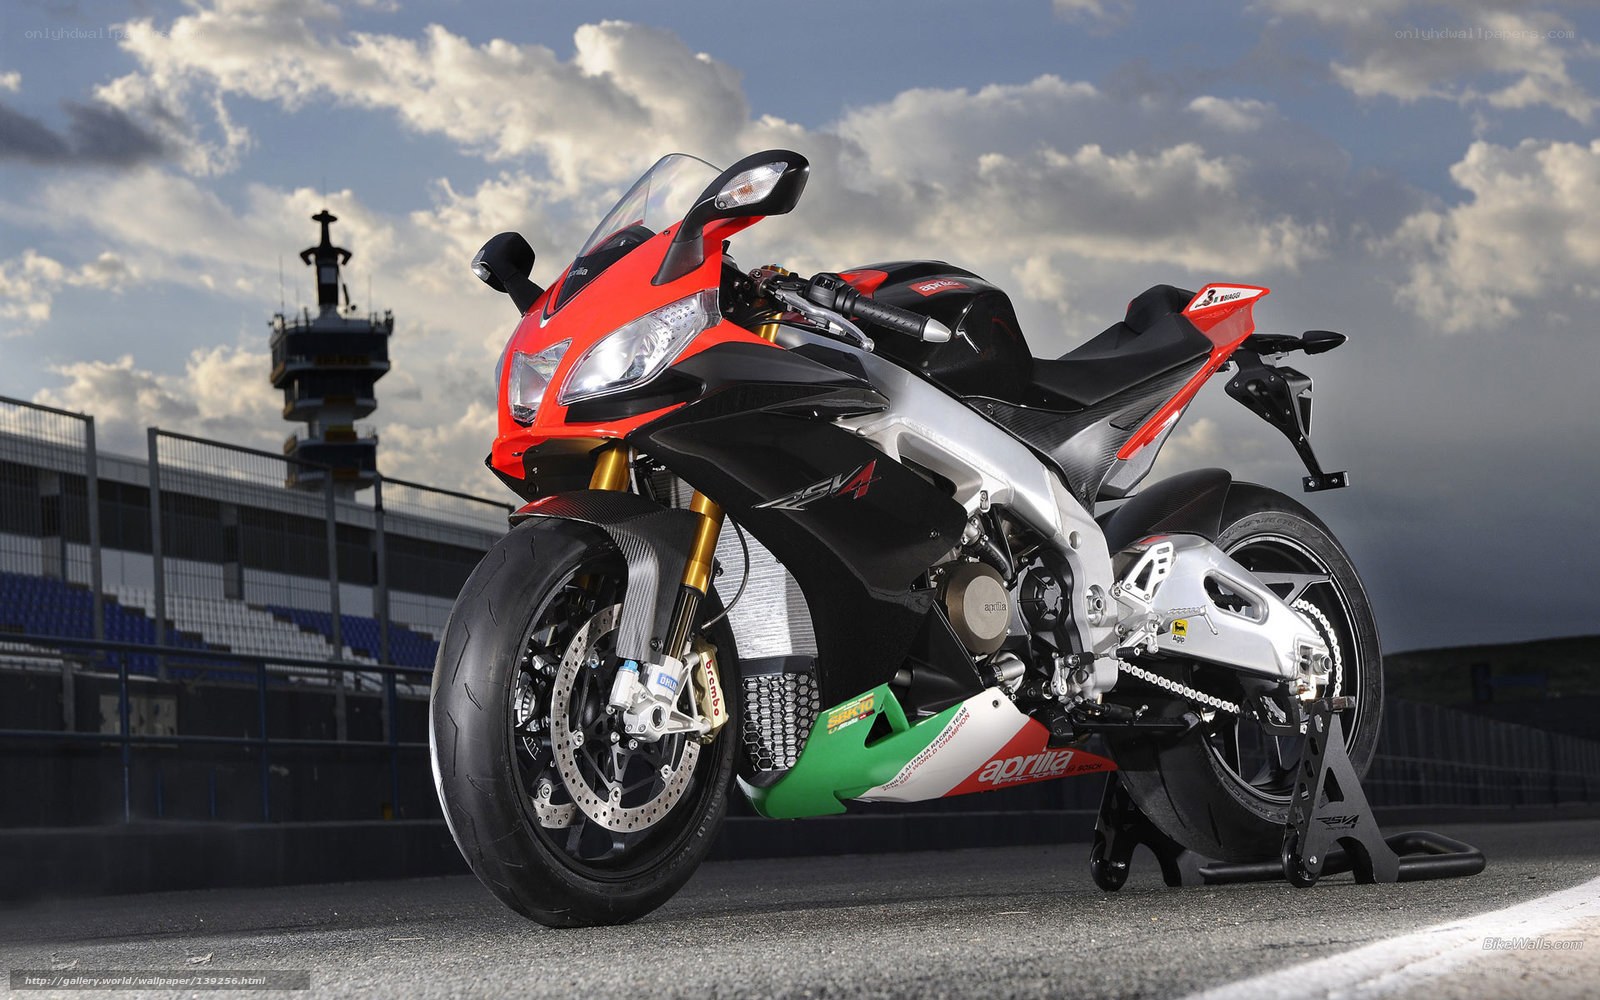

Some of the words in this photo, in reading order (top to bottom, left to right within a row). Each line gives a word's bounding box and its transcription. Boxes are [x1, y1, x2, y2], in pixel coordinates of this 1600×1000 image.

[567, 267, 589, 279] prilia
[919, 280, 960, 292] aprilia
[751, 458, 882, 511] RSV4
[984, 601, 1007, 613] aprilia
[705, 659, 721, 717] brembo
[899, 771, 913, 785] SBK
[912, 748, 938, 771] WORLD
[938, 712, 971, 749] CHAMPION
[905, 748, 930, 773] ALITALIA
[930, 725, 954, 749] RACING
[952, 706, 968, 726] TEAM
[977, 748, 1075, 786] aprilia
